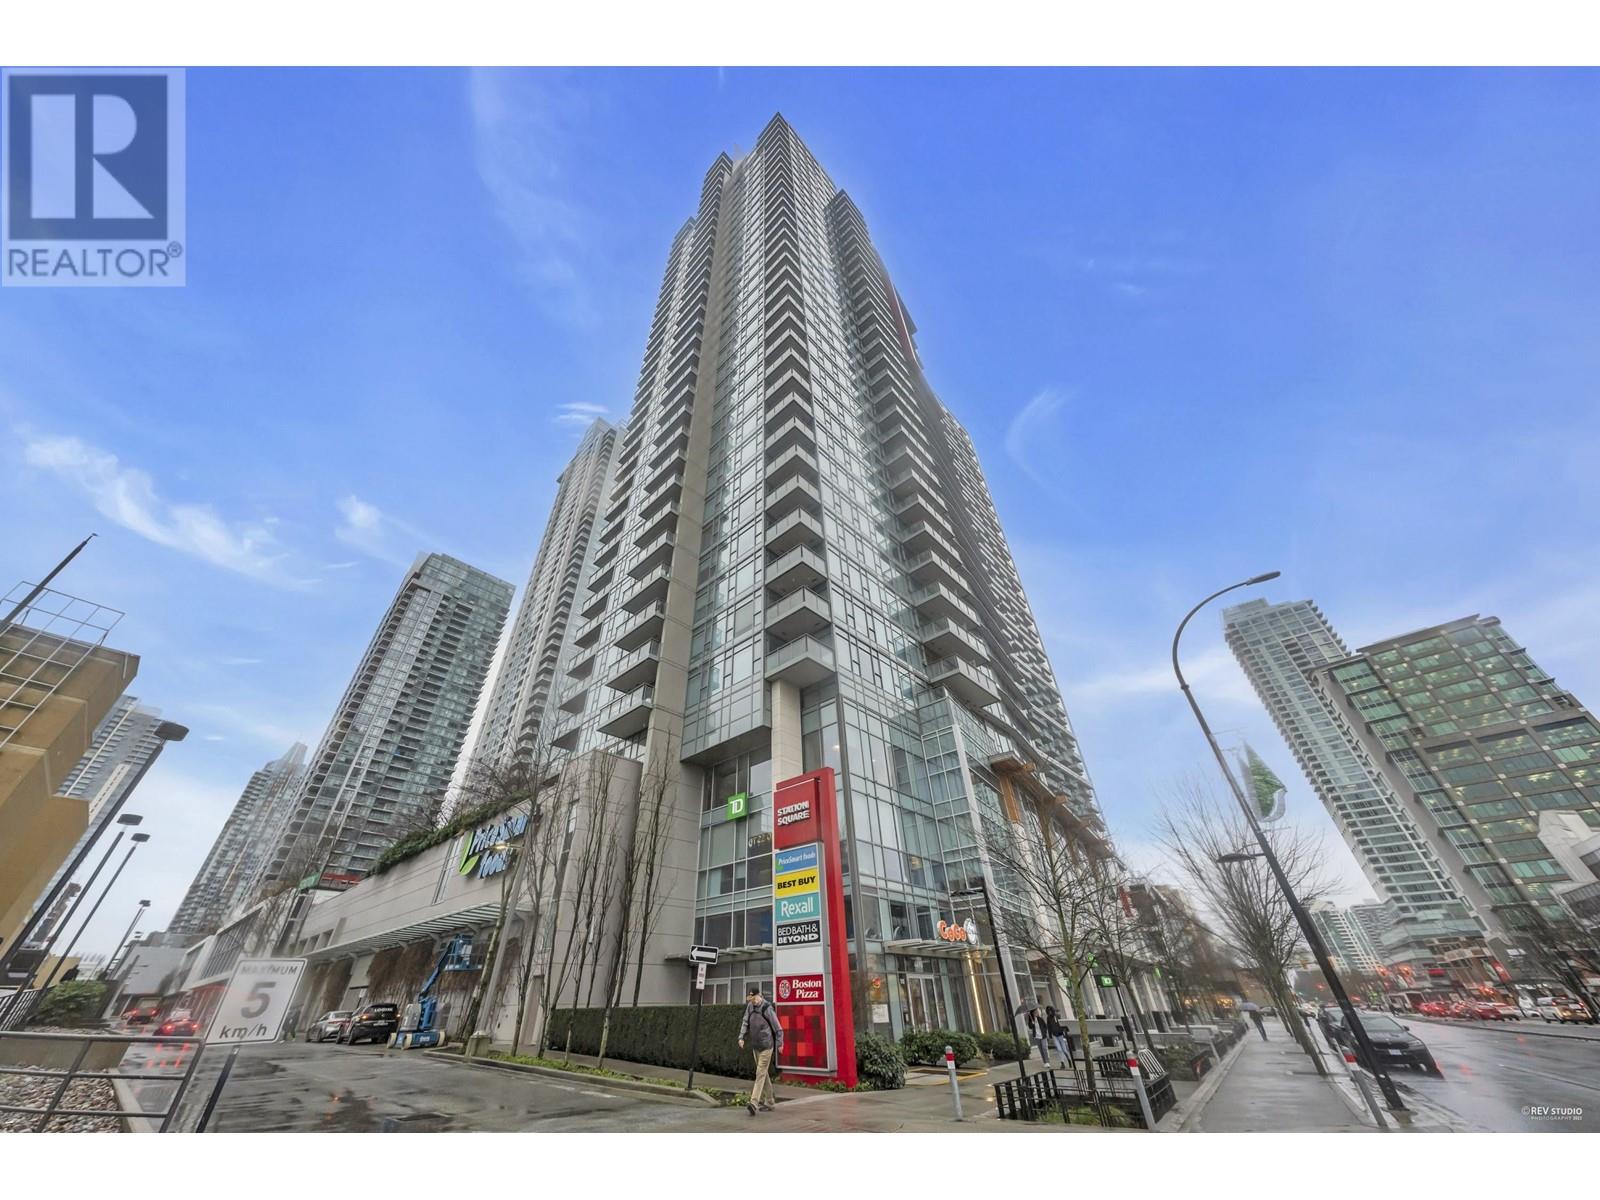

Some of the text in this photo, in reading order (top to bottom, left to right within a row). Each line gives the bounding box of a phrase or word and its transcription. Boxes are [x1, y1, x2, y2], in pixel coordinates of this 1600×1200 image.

[730, 798, 744, 815] TD
[777, 800, 810, 817] STATION
[777, 809, 810, 826] SQUARE
[777, 875, 816, 890] BEST BUY
[781, 896, 814, 918] Rexall
[777, 923, 818, 937] BED BATH &
[778, 933, 819, 944] BEYOND
[792, 979, 822, 989] Boston
[240, 981, 276, 1019] 5
[795, 988, 819, 999] Pizza
[219, 1023, 268, 1040] km/h
